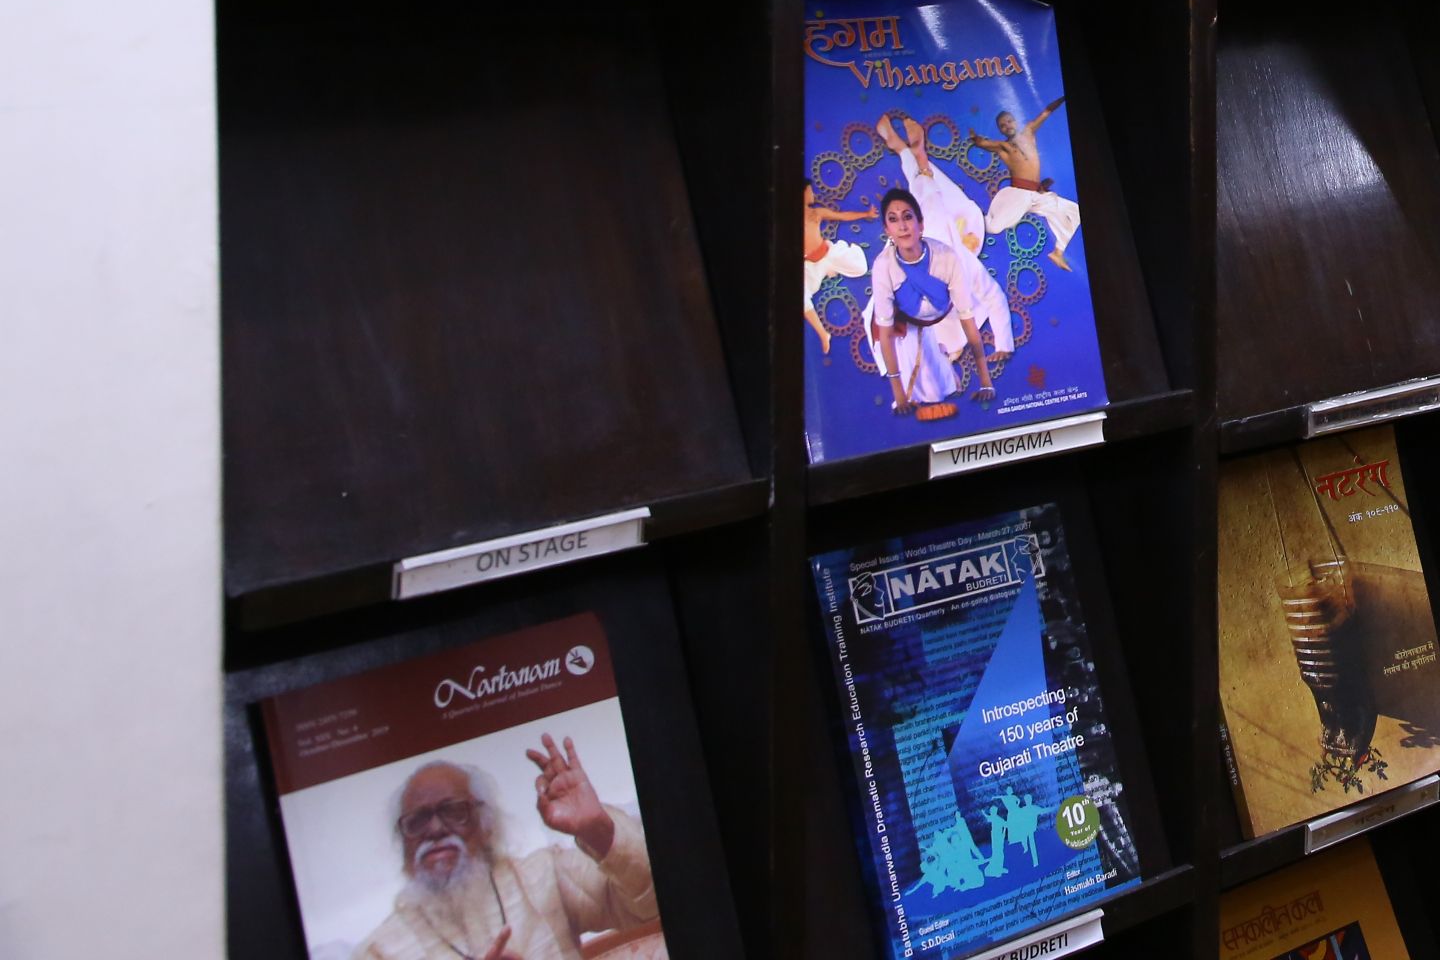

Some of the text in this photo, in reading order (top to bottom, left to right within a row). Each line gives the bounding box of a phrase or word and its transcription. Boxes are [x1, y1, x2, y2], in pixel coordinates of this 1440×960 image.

[850, 54, 1023, 91] Vihangama
[1025, 401, 1045, 411] NATIONAL
[1045, 399, 1060, 408] CENTRE
[1060, 397, 1069, 405] FOR
[1076, 392, 1088, 401] ARTS
[950, 430, 1053, 465] VIHANGAMA
[1315, 455, 1392, 502] नटरंग
[476, 531, 588, 573] ON STAGE
[850, 558, 878, 573] Special
[879, 553, 900, 565] Issue
[904, 544, 928, 559] World
[928, 538, 957, 554] Theatre
[957, 535, 973, 548] Day
[977, 527, 999, 541] March
[965, 574, 1008, 592] BUDRETI
[915, 608, 946, 623] Quarterly
[433, 654, 561, 709] Nartanam
[981, 687, 1066, 724] Introspecting
[999, 705, 1079, 745] 150 years of
[822, 566, 914, 958] Batubhai Umarwadia Dramatic Research Education Training Institute
[979, 731, 1085, 779] Gujarati Theatre
[1065, 830, 1097, 848] Publication
[1064, 868, 1118, 895] Hasmukh Baradi
[1066, 869, 1081, 880] Editor
[920, 929, 955, 952] S.D.Desai
[1010, 933, 1069, 960] BUDRETI
